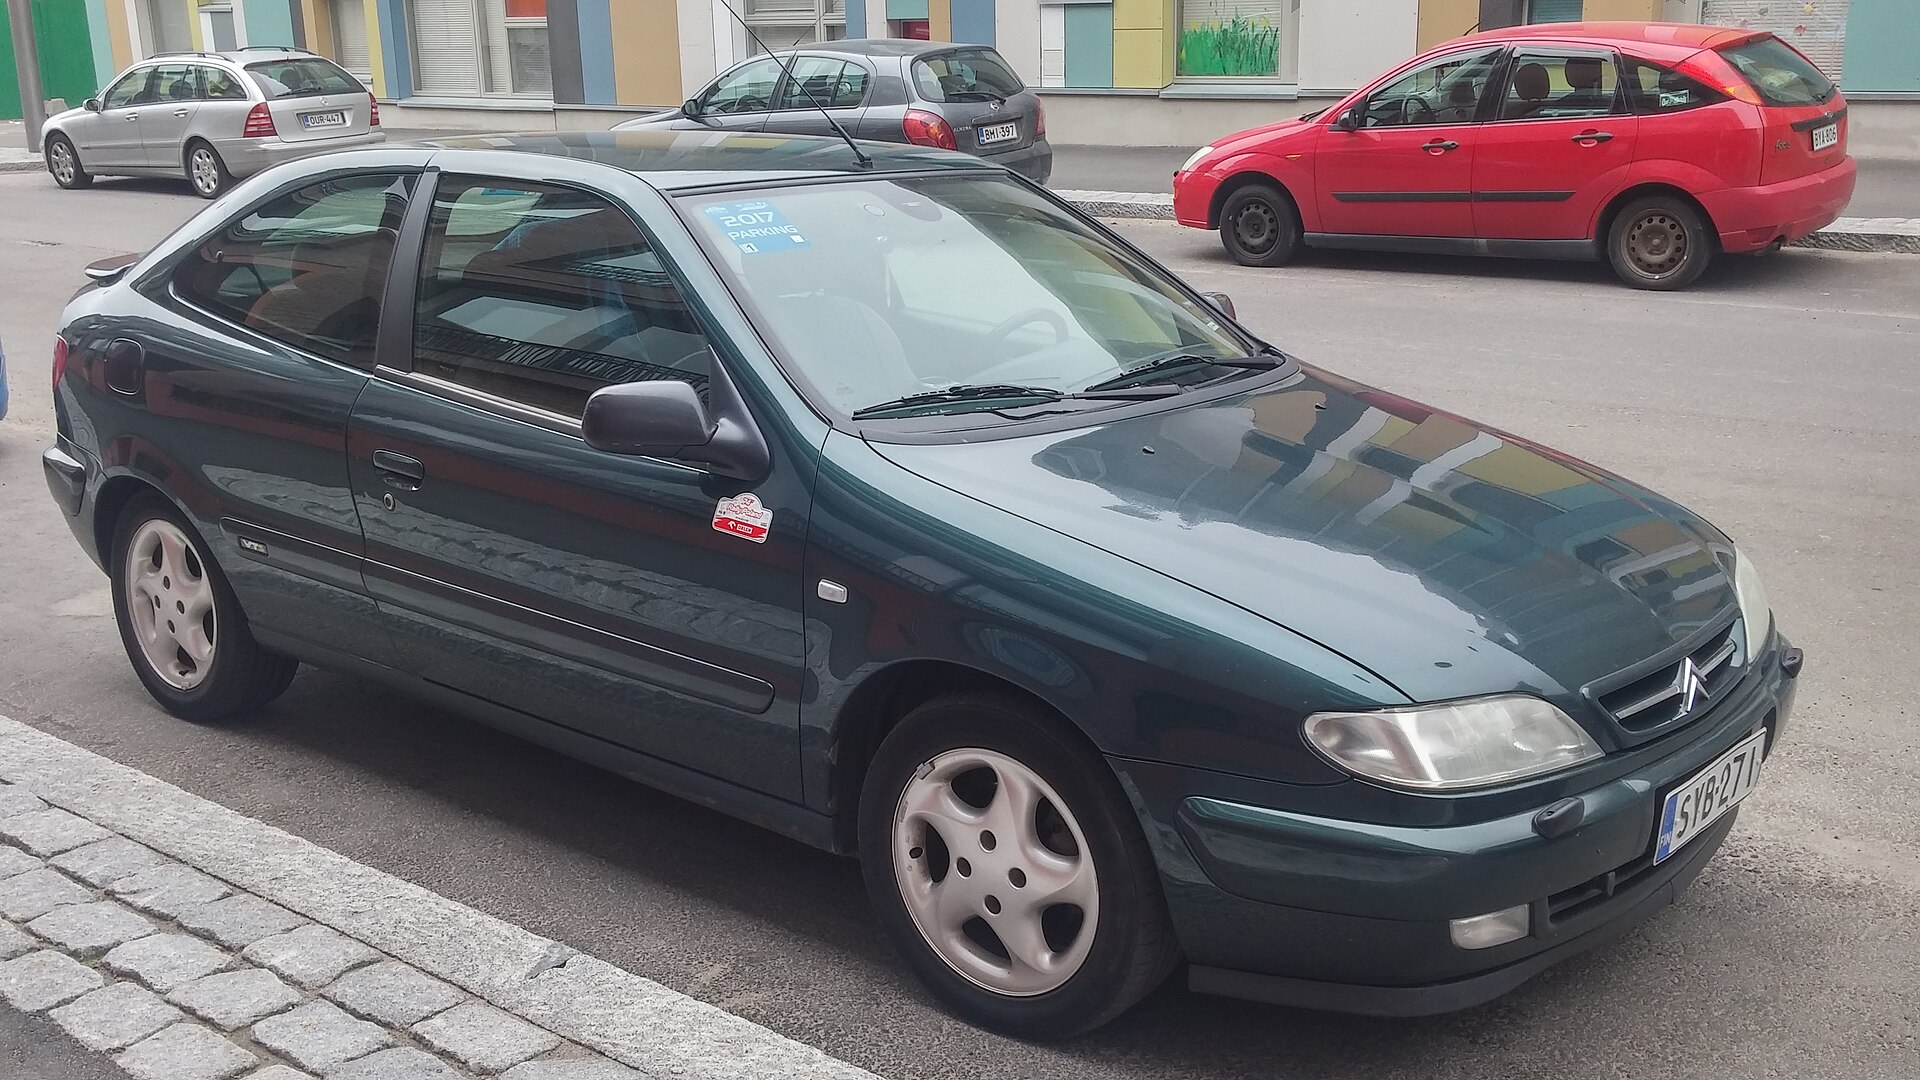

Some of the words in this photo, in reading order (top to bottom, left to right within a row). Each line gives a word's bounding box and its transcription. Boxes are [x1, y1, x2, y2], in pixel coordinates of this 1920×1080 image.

[309, 114, 340, 125] OUR-447
[985, 125, 1014, 140] BMI-397
[1815, 127, 1837, 147] BYA-806
[720, 211, 774, 227] 2017
[728, 225, 799, 241] PARKING
[1677, 746, 1756, 839] SYB-271
[1660, 831, 1673, 847] FIN
